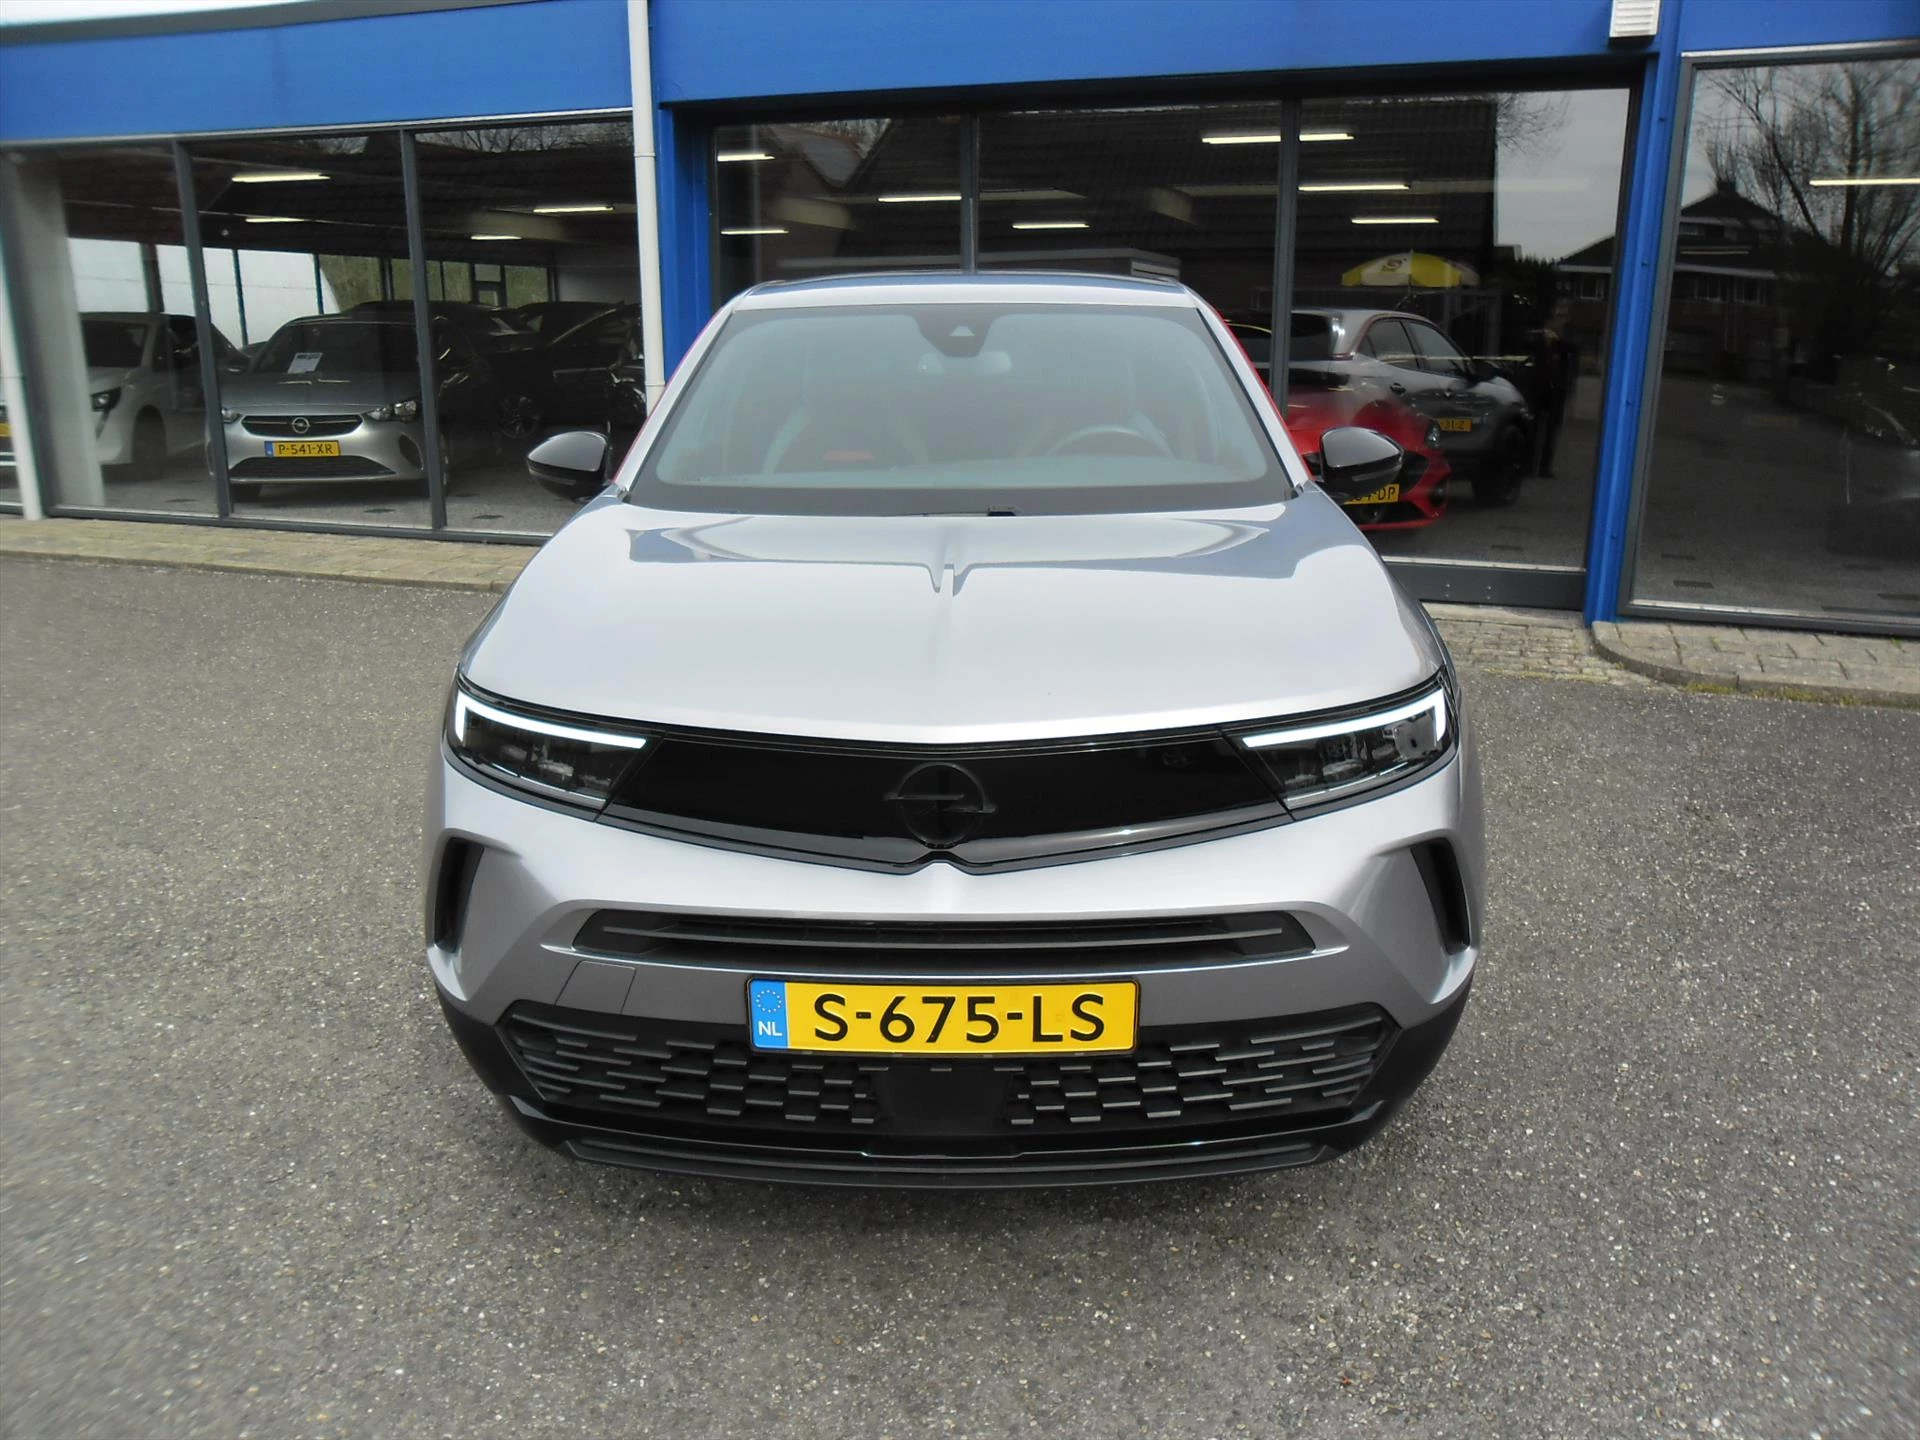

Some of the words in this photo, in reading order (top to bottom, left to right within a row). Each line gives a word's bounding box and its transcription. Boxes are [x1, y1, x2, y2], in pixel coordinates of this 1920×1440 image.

[278, 443, 334, 455] P-541-XR
[813, 992, 1105, 1044] S-675-LS
[758, 1020, 783, 1037] NL
